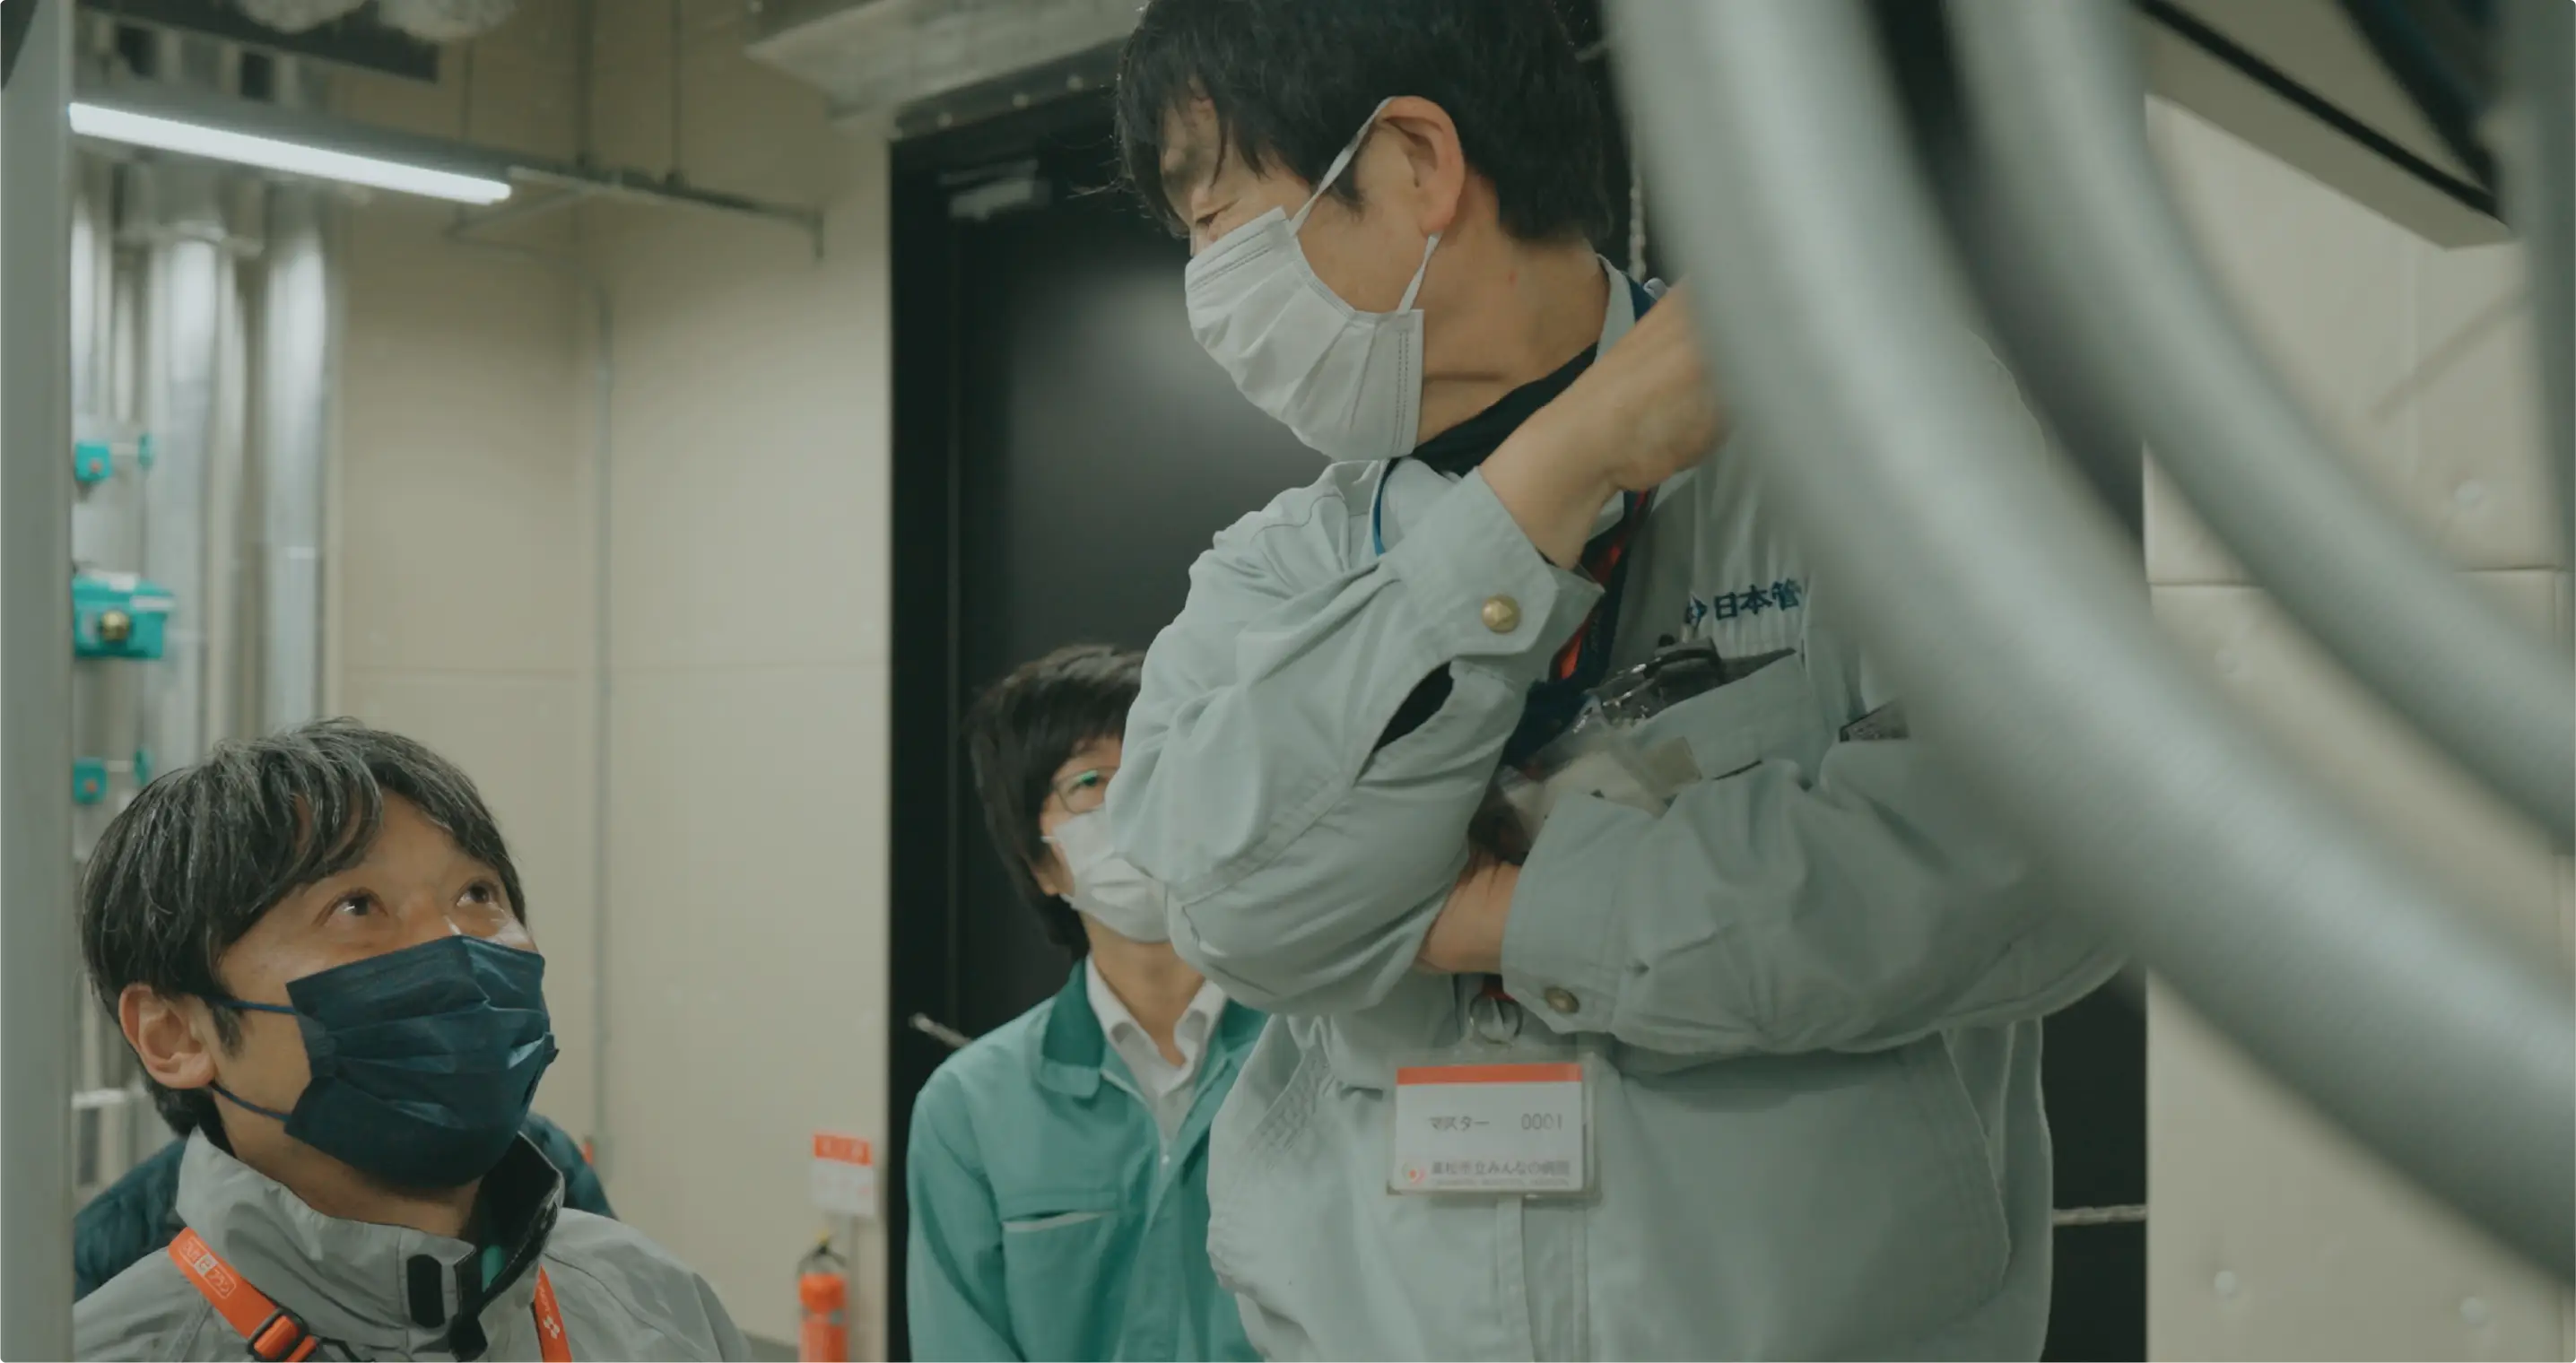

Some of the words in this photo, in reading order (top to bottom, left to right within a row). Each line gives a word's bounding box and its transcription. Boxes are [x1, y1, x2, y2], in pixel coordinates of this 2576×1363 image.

[1427, 1115, 1491, 1132] マスター
[1520, 1112, 1563, 1132] 0001
